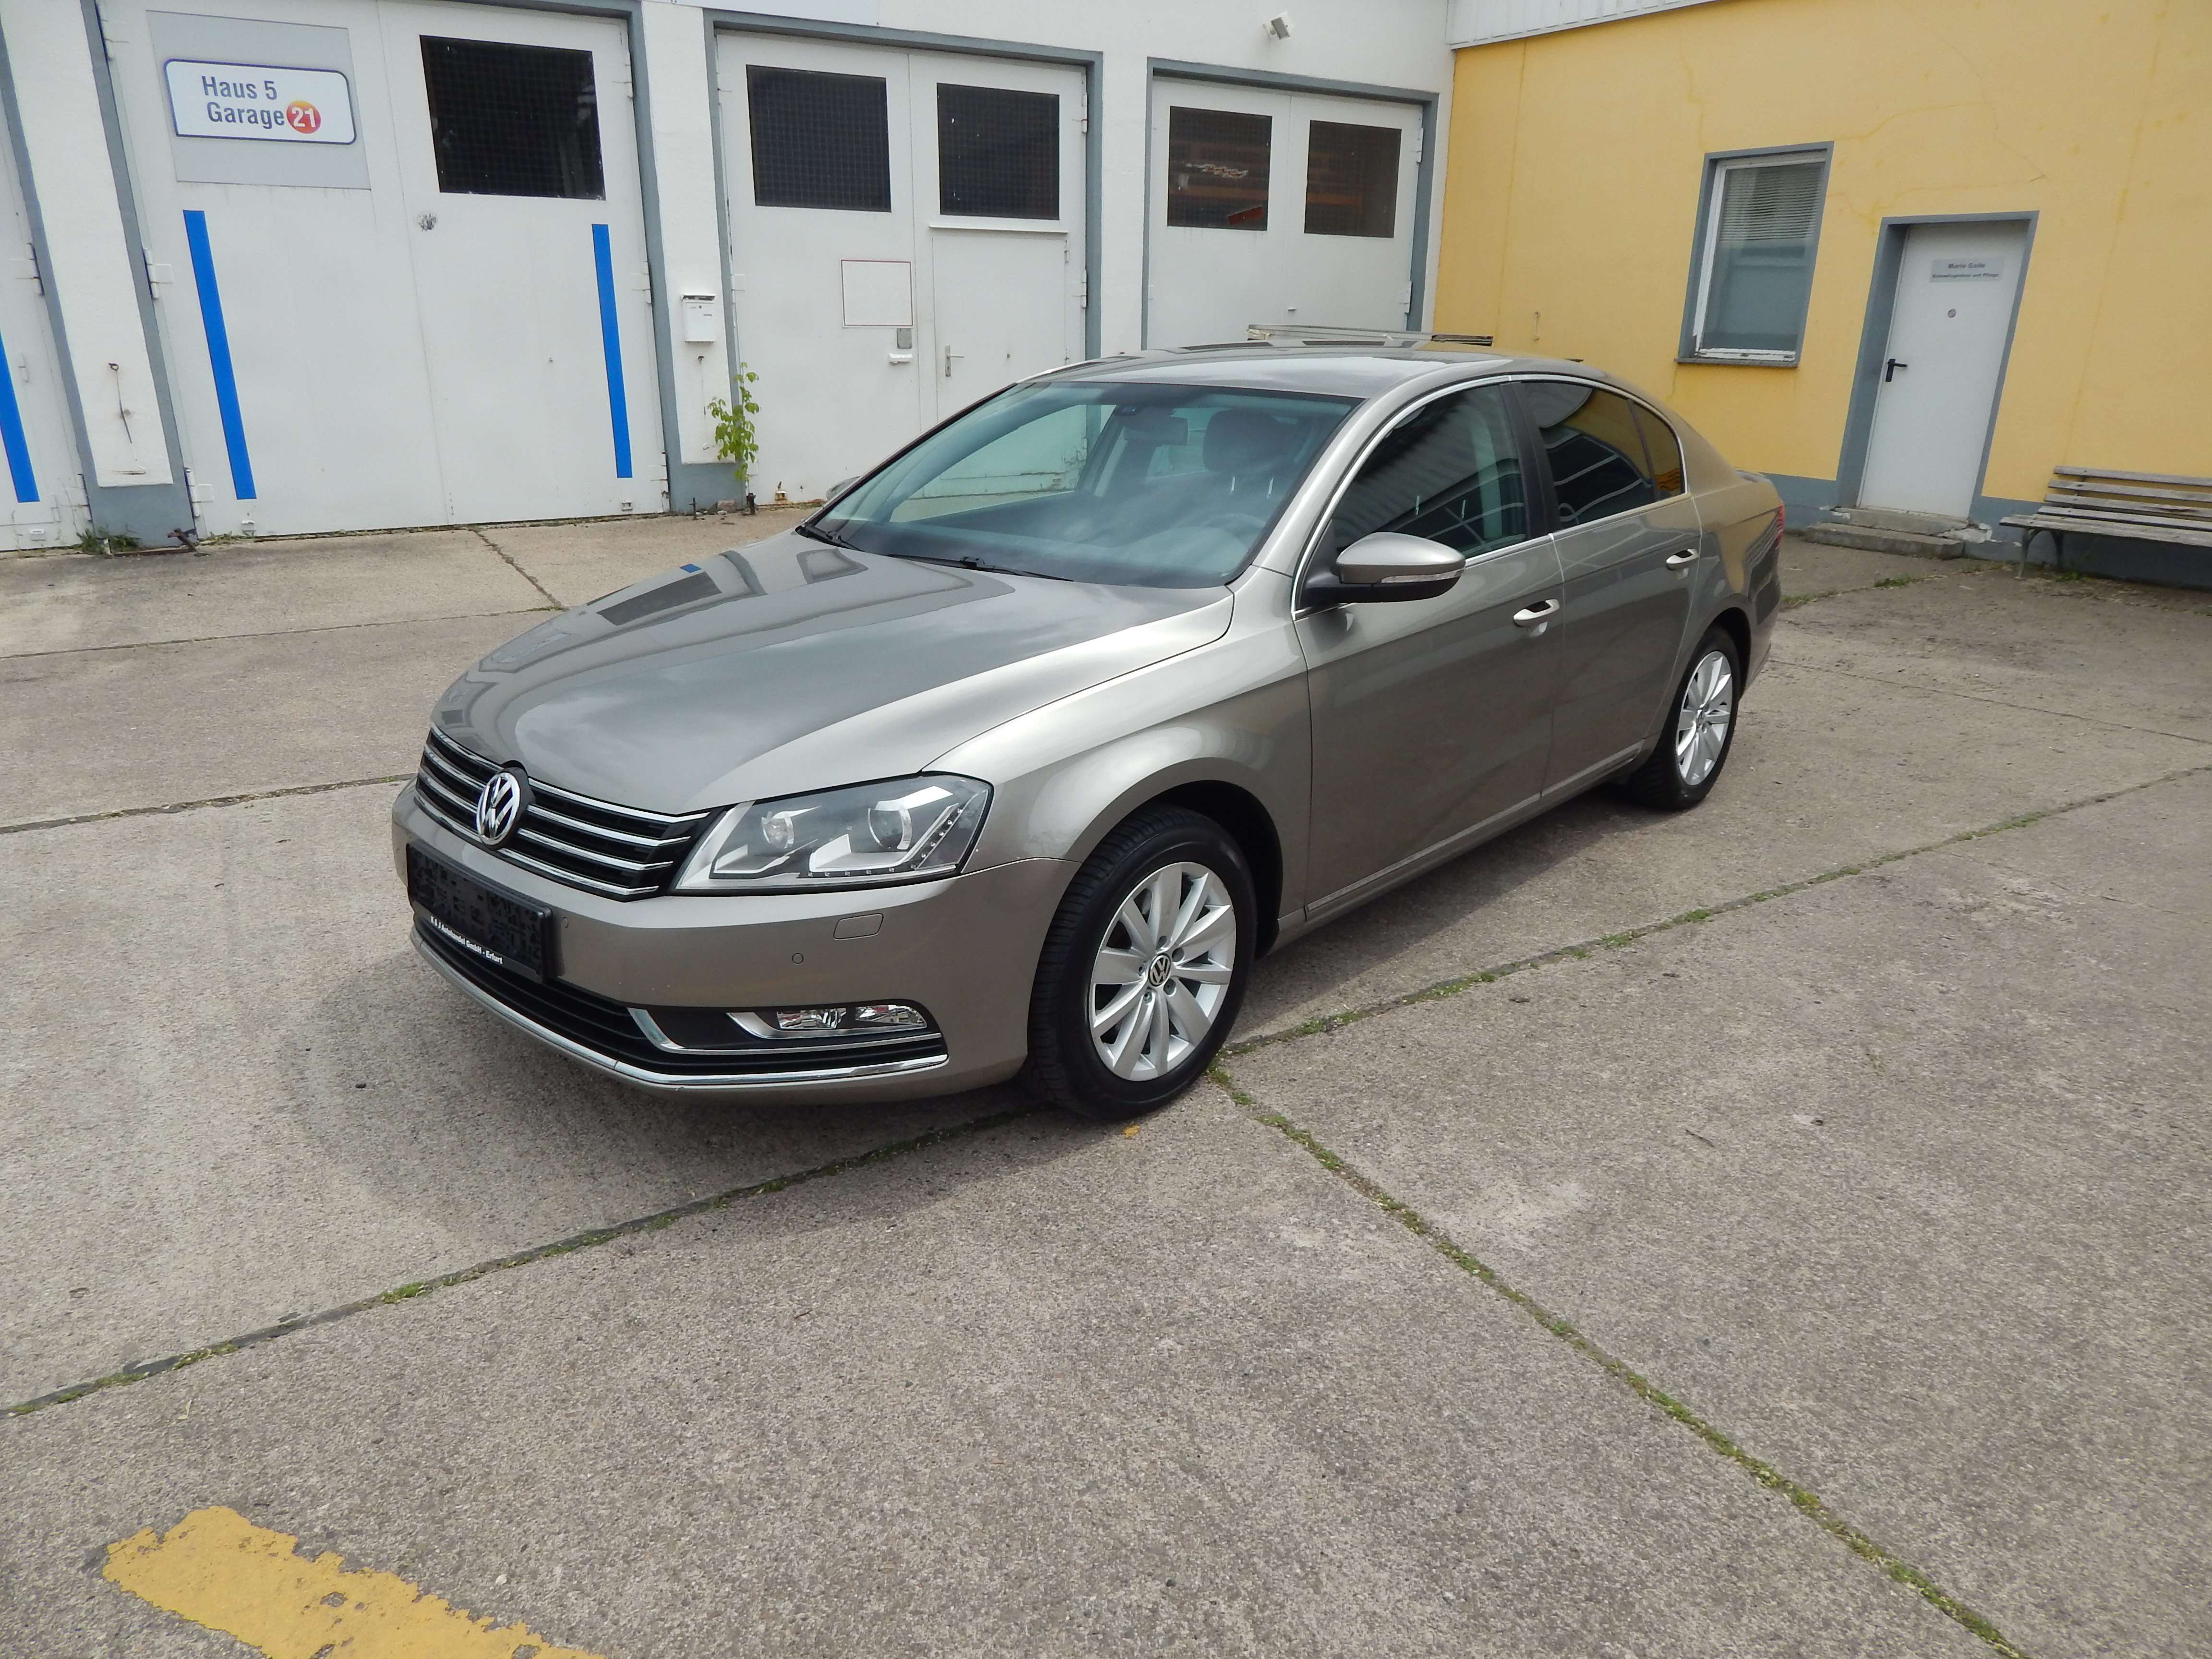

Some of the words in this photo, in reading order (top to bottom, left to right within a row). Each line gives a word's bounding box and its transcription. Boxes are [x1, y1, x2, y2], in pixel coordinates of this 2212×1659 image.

[202, 76, 257, 99] Haus
[264, 80, 277, 100] 5
[207, 101, 285, 129] Garage
[291, 107, 316, 128] 21
[466, 940, 481, 954] GmbH
[485, 950, 503, 964] Erfurt
